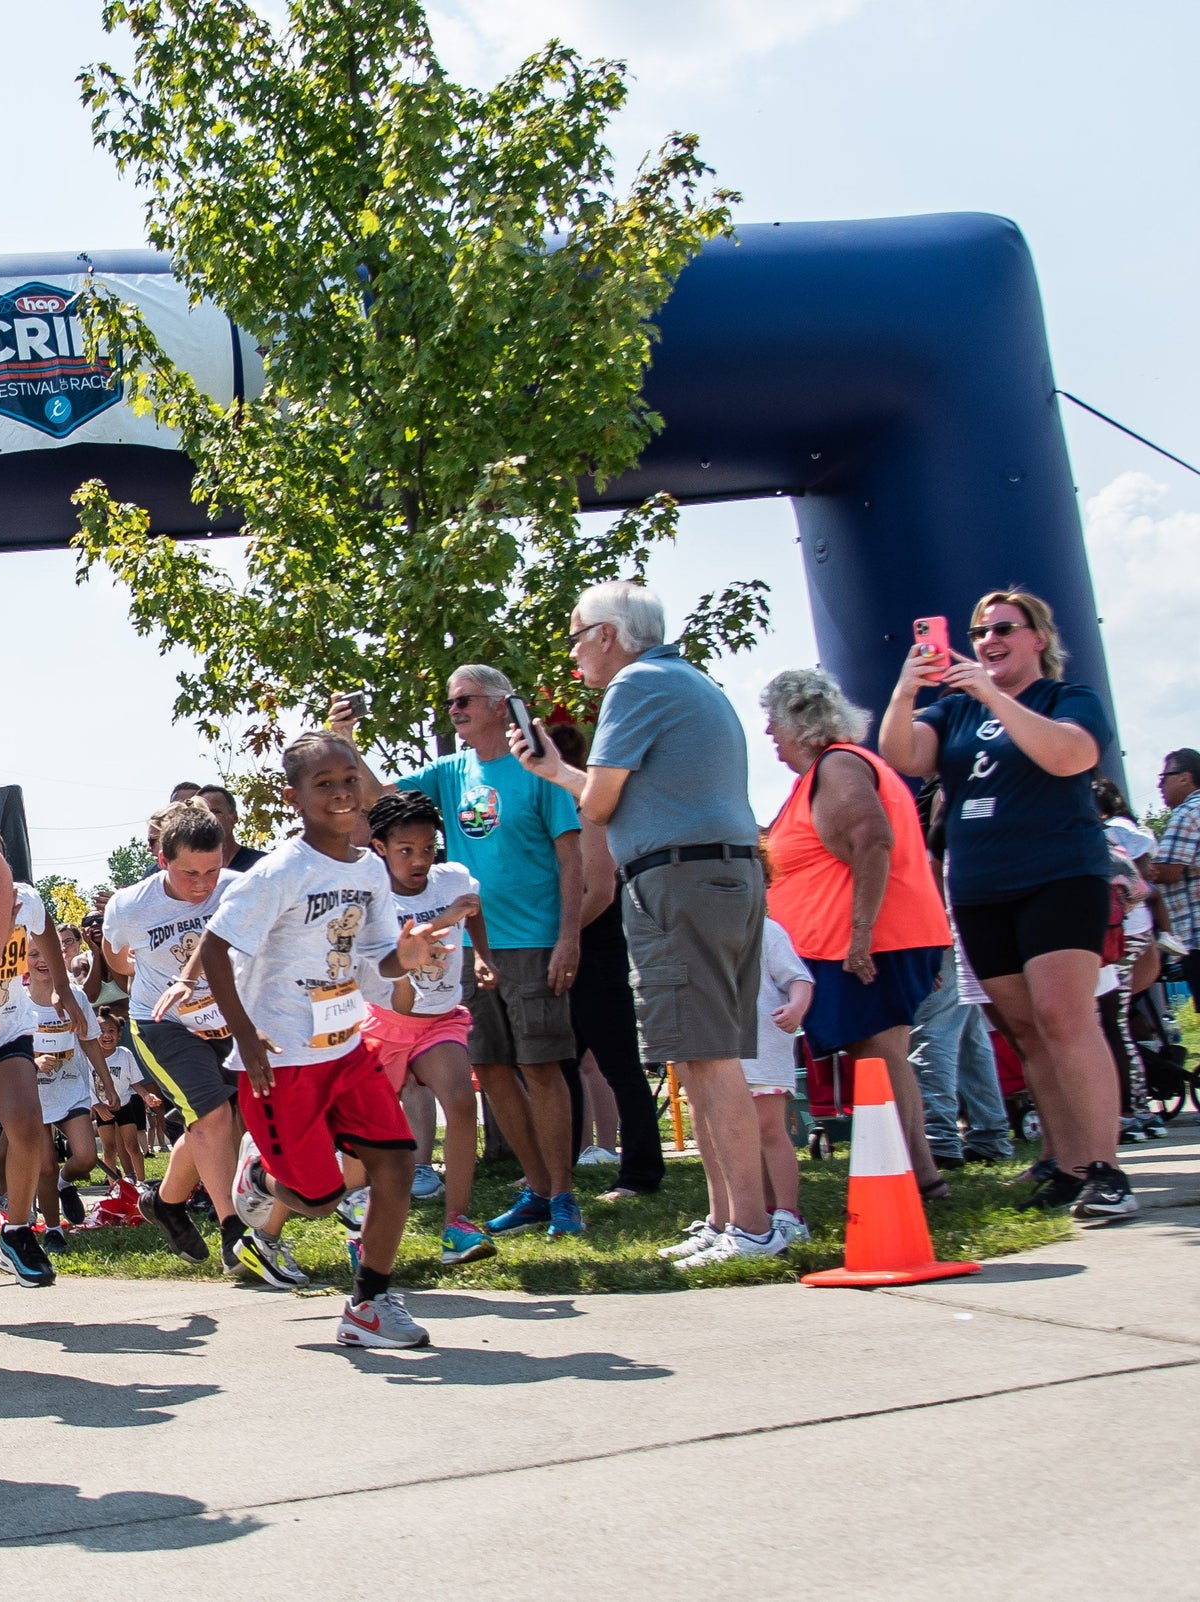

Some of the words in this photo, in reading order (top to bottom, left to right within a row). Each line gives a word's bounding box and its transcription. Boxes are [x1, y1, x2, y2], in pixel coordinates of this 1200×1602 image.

[22, 297, 60, 313] hap
[70, 375, 115, 391] RACE
[305, 892, 340, 924] TEDDY
[147, 921, 175, 951] TEDDY
[178, 913, 201, 933] BEAR
